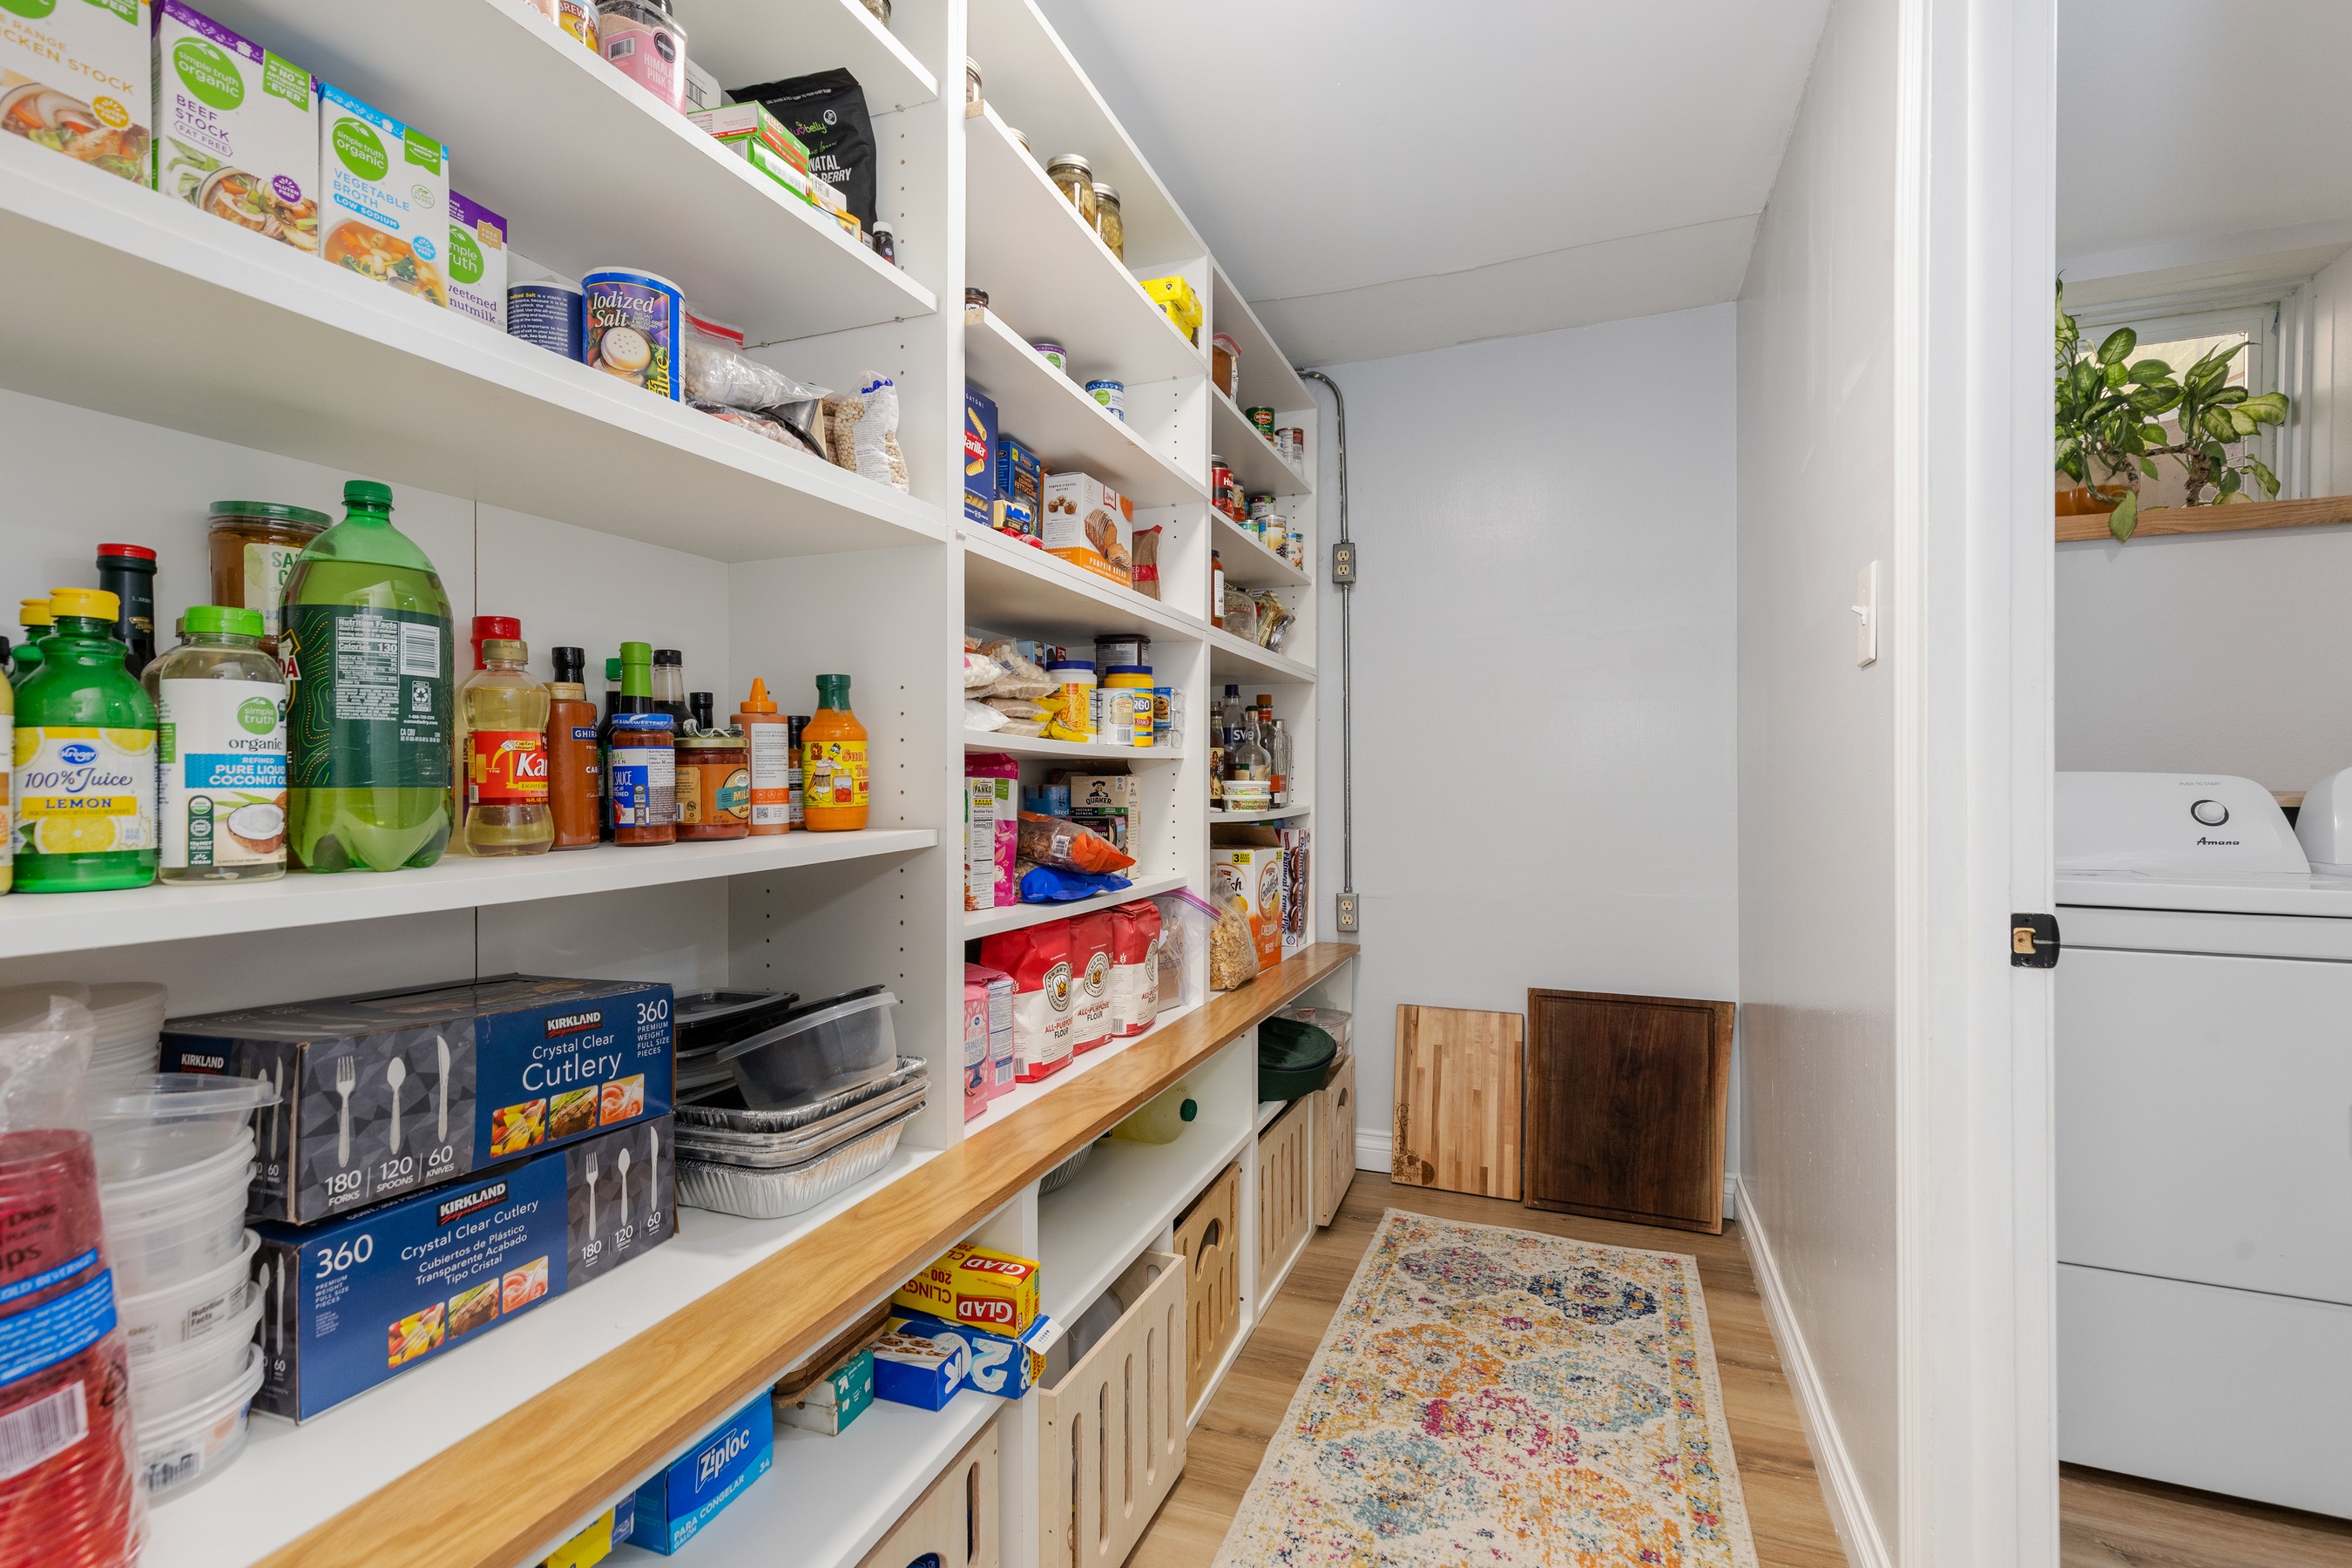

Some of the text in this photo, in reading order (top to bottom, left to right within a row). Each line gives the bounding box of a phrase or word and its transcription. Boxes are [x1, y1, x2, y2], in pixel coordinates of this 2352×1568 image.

[13, 21, 66, 51] RANGE
[68, 58, 134, 96] STOCK
[179, 51, 240, 87] simple truth
[279, 69, 294, 82] NO
[647, 67, 666, 88] PINK
[179, 61, 240, 98] organic
[95, 104, 127, 121] GLUTEN
[177, 94, 218, 121] BEEF
[101, 112, 122, 125] FREE
[175, 107, 230, 143] STOCK
[179, 125, 228, 153] FAT FREE
[336, 131, 384, 160] simple truth
[336, 139, 384, 169] organic
[406, 139, 440, 157] ORGANICALLY
[413, 147, 433, 159] GROWN
[274, 181, 299, 196] GLUTEN
[278, 188, 295, 199] FREE
[334, 180, 378, 209] BROTH
[335, 167, 410, 212] VEGETABLE
[414, 190, 433, 201] PLANT
[414, 195, 433, 206] BASED
[336, 194, 397, 228] LOW SODIUM
[481, 227, 498, 238] FREE
[481, 233, 498, 243] FROM
[414, 241, 435, 253] GLUTEN
[417, 248, 433, 258] FREE
[449, 240, 477, 260] mple
[449, 253, 477, 274] ruth
[592, 291, 655, 314] Iodized
[595, 309, 630, 328] Salt
[965, 393, 984, 409] GATONI
[1090, 557, 1112, 572] PUMPKIN
[1113, 566, 1126, 578] BREAD
[338, 618, 374, 627] Nutrition
[377, 643, 398, 652] 130
[244, 706, 274, 717] simple
[244, 714, 274, 725] truth
[228, 737, 282, 752] organic
[61, 747, 96, 762] Kroger
[841, 749, 863, 762] Sun
[215, 764, 286, 774] PURE LIQUID
[24, 767, 133, 794] 100% Juice
[209, 775, 276, 785] COCONUT
[614, 770, 632, 786] SAUCE
[974, 784, 992, 794] PANKO
[45, 798, 112, 809] LEMON
[1085, 797, 1112, 806] QUAKER
[2196, 836, 2240, 846] Amana
[1233, 854, 1240, 862] 3
[1282, 852, 1291, 887] Oatmeal
[1261, 921, 1278, 936] CHEDDAR
[637, 998, 668, 1024] 360
[1078, 1002, 1110, 1017] ALL-PURPOSE
[1086, 1010, 1103, 1022] FLOUR
[547, 1010, 602, 1031] KIRKLAND
[637, 1021, 669, 1034] PREMIUM
[547, 1024, 603, 1038] Signature
[637, 1029, 666, 1042] WEIGHT
[1054, 1028, 1069, 1038] FLOUR
[532, 1033, 615, 1061] Crystal Clear
[637, 1036, 671, 1051] FULL SIZE
[637, 1046, 662, 1058] PIECES
[180, 1053, 225, 1069] KIRKLAND
[523, 1052, 623, 1092] Cutlery
[427, 1144, 454, 1167] 60
[267, 1164, 280, 1176] 60
[379, 1155, 414, 1181] 120
[425, 1161, 456, 1179] KNIVES
[324, 1169, 362, 1198] 180
[375, 1173, 415, 1194] SPOONS
[328, 1189, 361, 1207] FORKS
[440, 1183, 507, 1217] KIRKLAND
[440, 1196, 507, 1226] Signature
[647, 1211, 661, 1227] 60
[401, 1200, 540, 1261] Crystal Clear Cutlery
[614, 1225, 633, 1244] 120
[419, 1224, 525, 1274] Cubiertos de Plástico
[581, 1240, 602, 1260] 180
[617, 1238, 632, 1248] SPOONS
[315, 1233, 374, 1279] 360
[416, 1233, 528, 1287] Transparente Acabado
[585, 1254, 598, 1264] FORKS
[445, 1254, 504, 1286] Tipo Cristal
[963, 1258, 1026, 1276] GLAD
[315, 1274, 348, 1291] PREMIUM
[931, 1269, 952, 1285] 200
[315, 1281, 344, 1298] WEIGHT
[315, 1285, 350, 1304] FULL SIZE
[191, 1297, 225, 1319] Nutrition
[315, 1295, 341, 1309] PIECES
[191, 1312, 213, 1326] Facts
[958, 1301, 1013, 1323] GLAD
[274, 1359, 287, 1372] 60
[700, 1429, 750, 1483] Ziploc
[759, 1457, 770, 1473] 34
[673, 1475, 745, 1542] PARA CONGELAR
